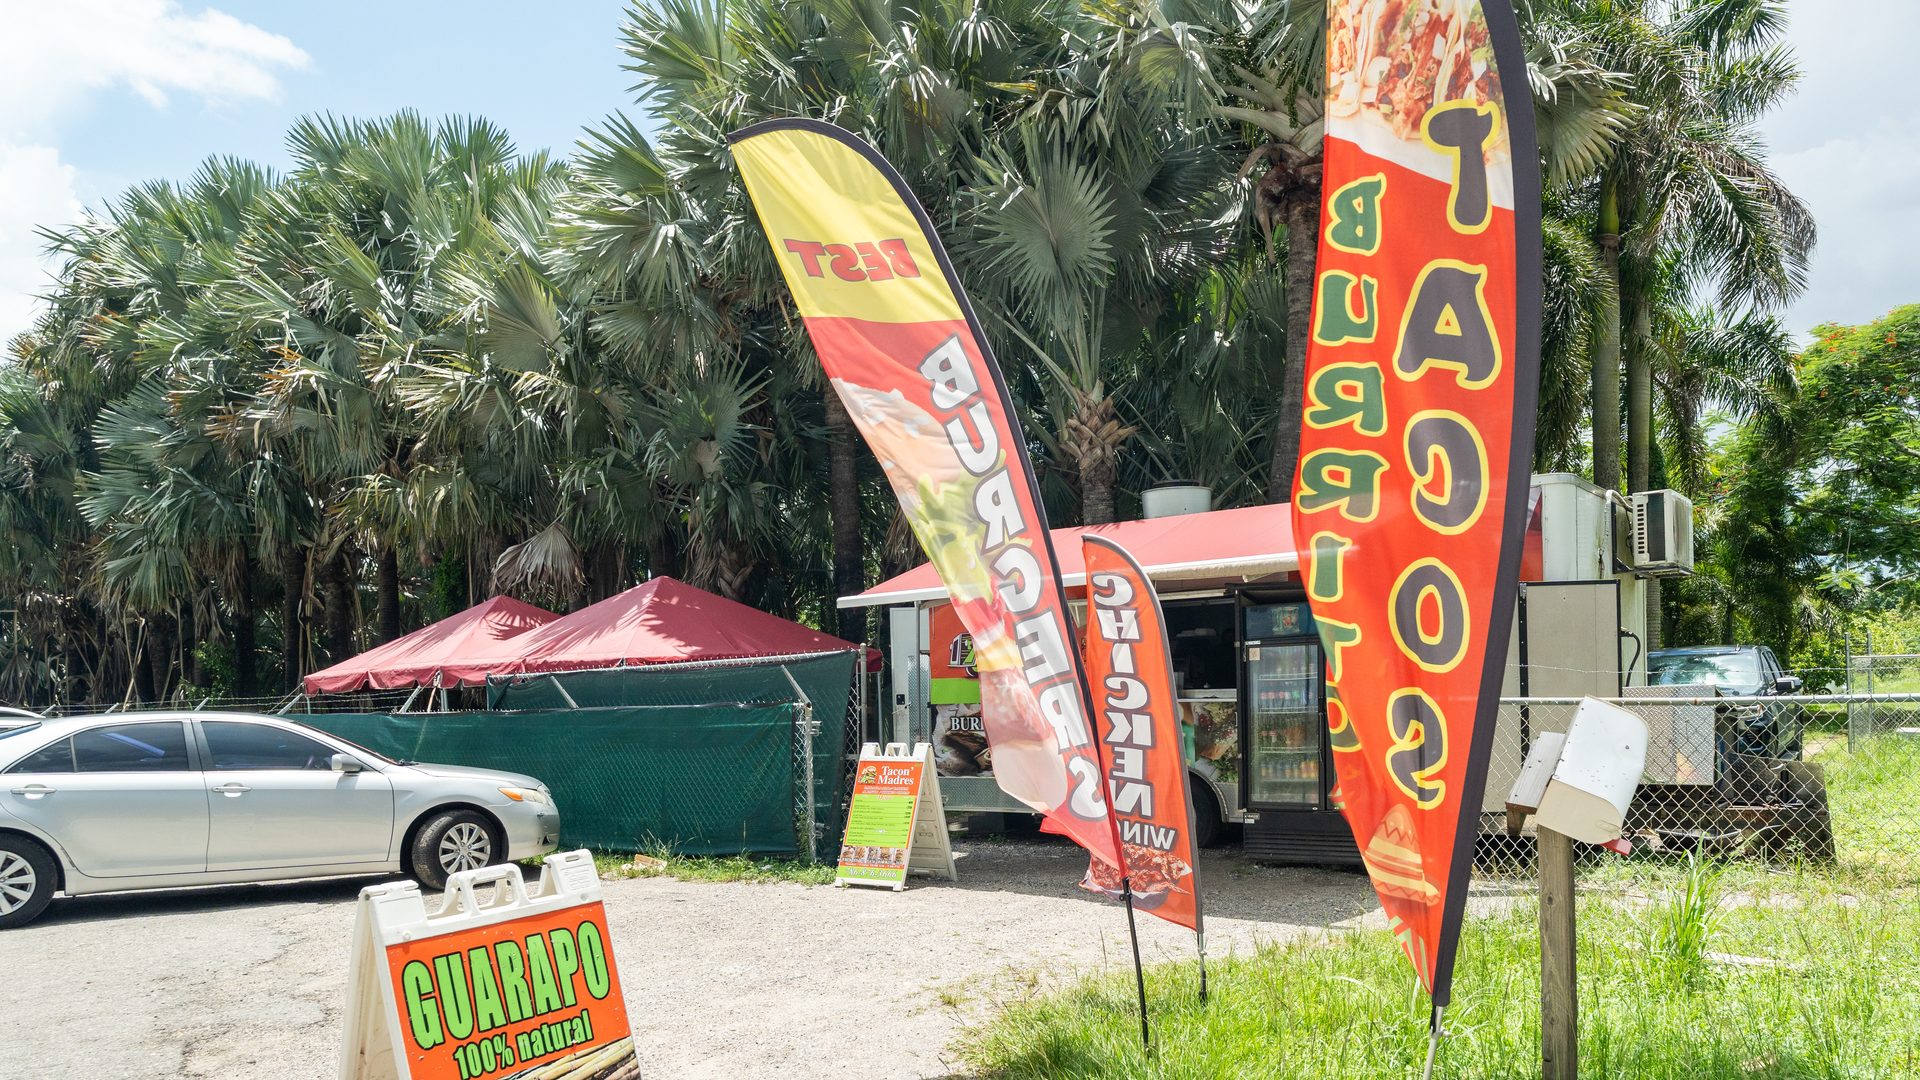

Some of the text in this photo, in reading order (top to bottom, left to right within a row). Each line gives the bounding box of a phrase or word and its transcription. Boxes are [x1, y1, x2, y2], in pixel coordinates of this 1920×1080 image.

[877, 775, 914, 785] Madres
[402, 920, 610, 1050] GUARAPO
[453, 1009, 594, 1080] 100% natural
